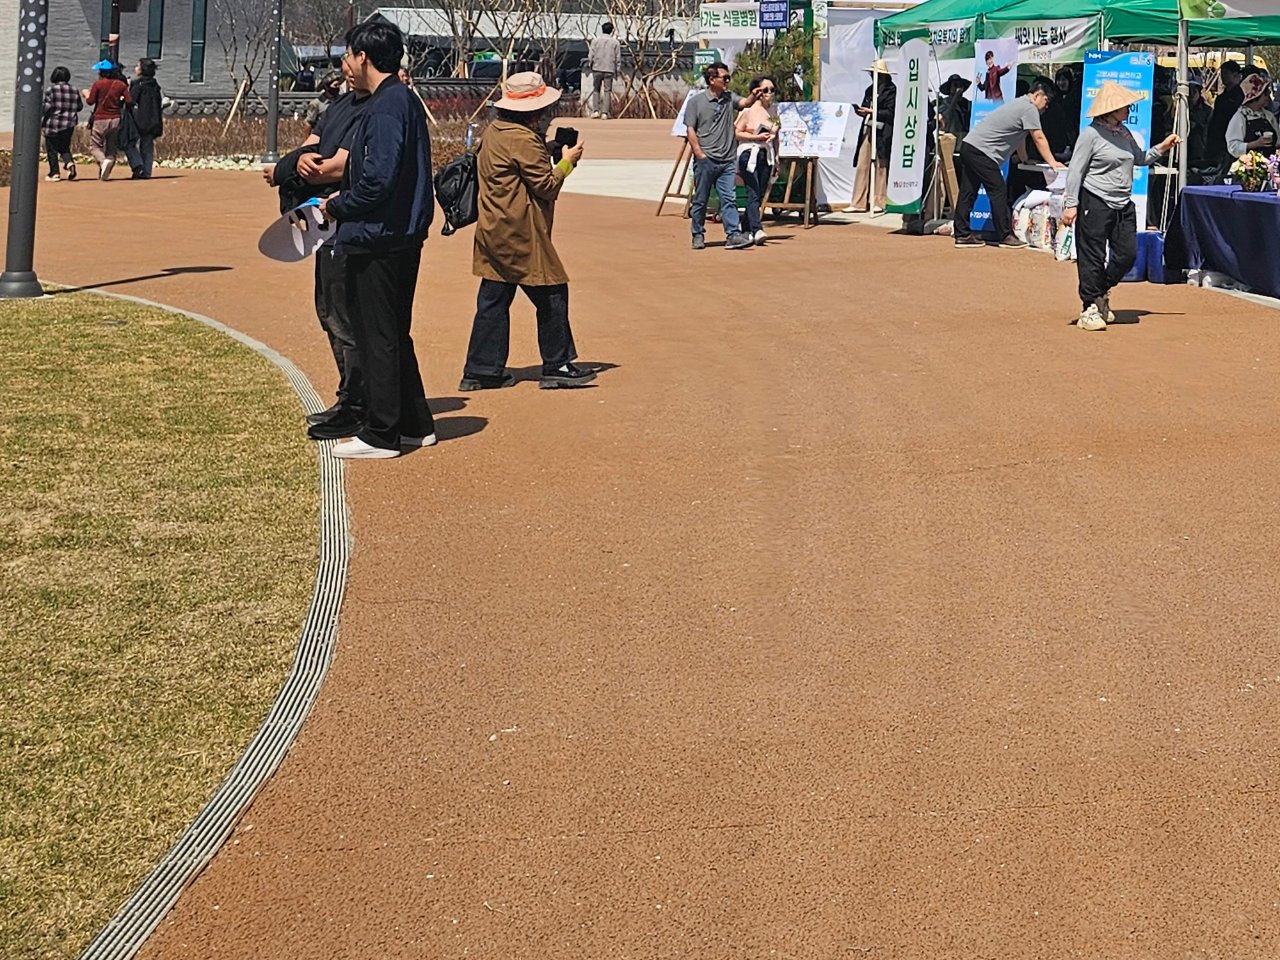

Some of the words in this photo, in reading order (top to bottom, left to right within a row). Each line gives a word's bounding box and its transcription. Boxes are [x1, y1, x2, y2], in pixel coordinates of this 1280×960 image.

[723, 9, 757, 28] 식물병원
[1032, 26, 1049, 46] 나눔
[1050, 25, 1067, 46] 행사
[902, 57, 920, 169] 입시상담
